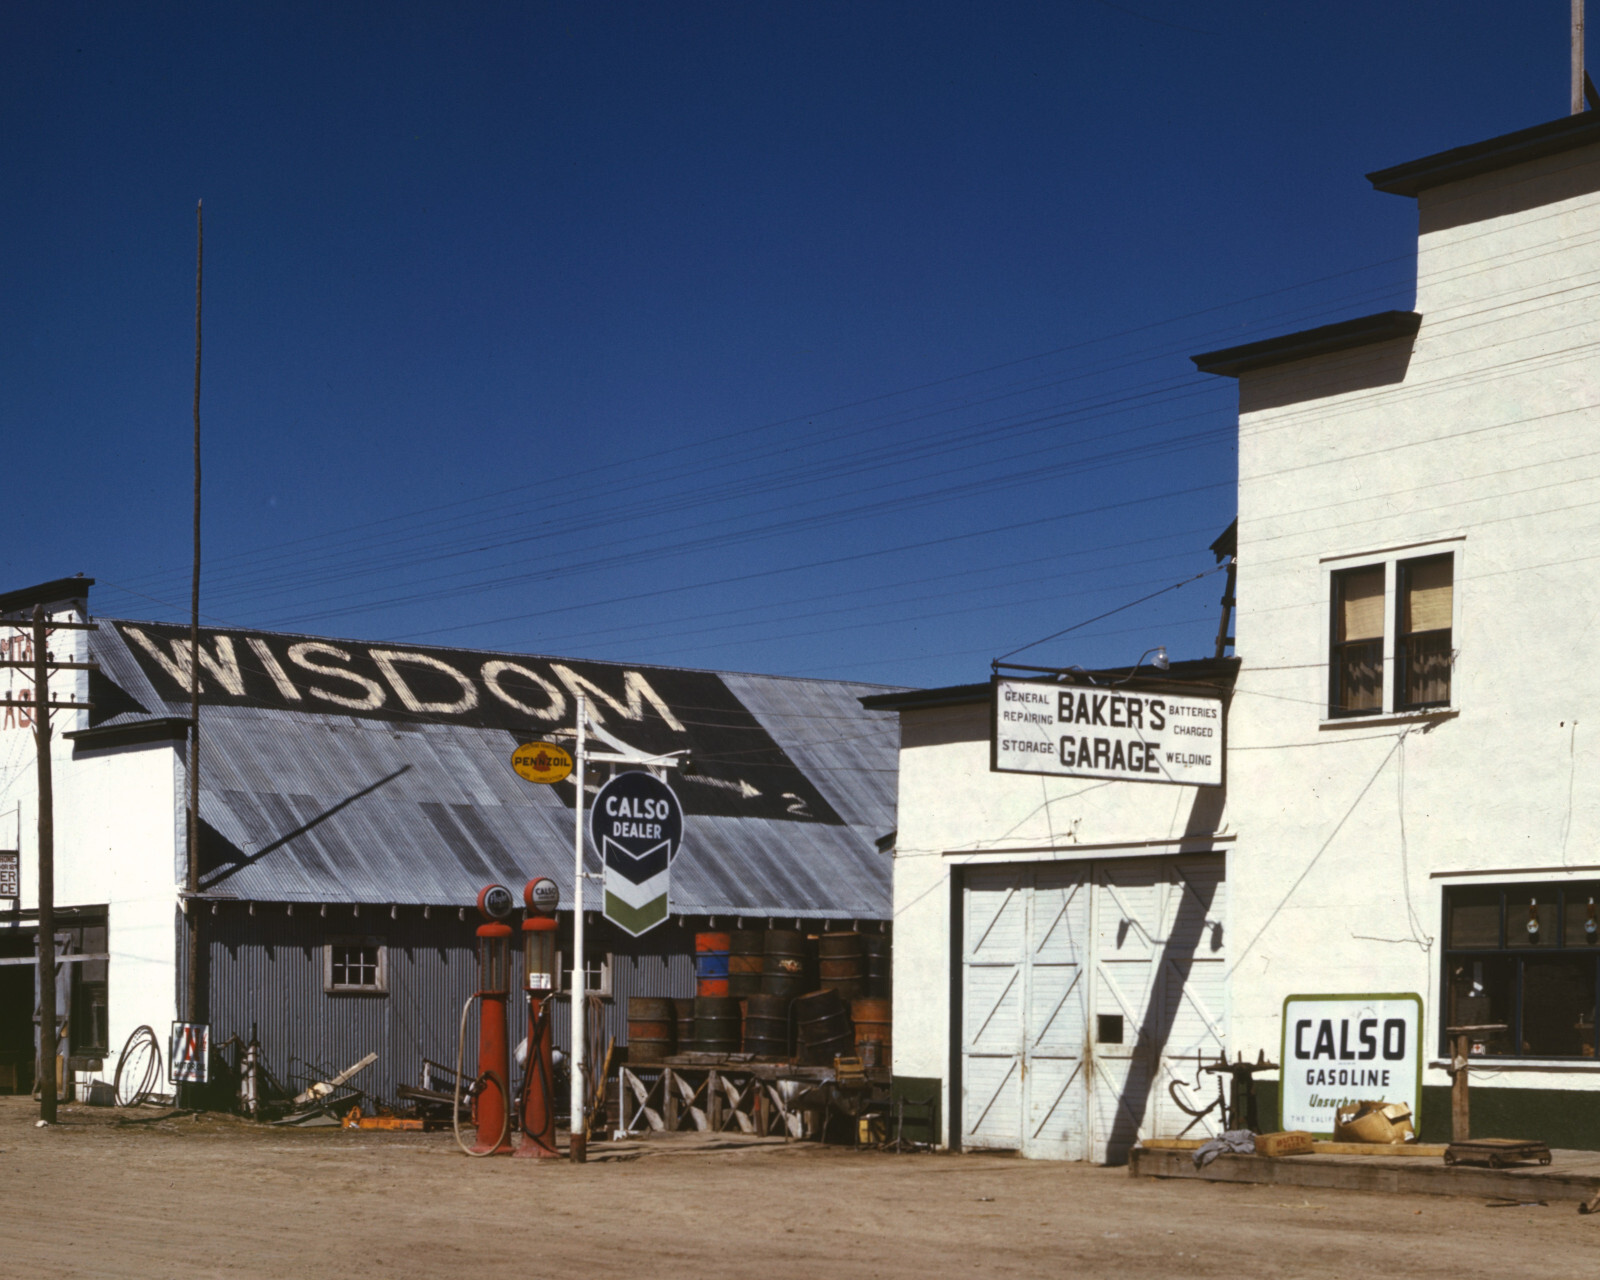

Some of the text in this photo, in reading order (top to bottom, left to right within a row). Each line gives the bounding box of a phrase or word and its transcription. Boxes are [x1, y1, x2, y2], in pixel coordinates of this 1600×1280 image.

[122, 625, 687, 732] WISDOM
[1005, 691, 1050, 705] GENERAL
[1004, 711, 1053, 725] REPAIRING
[1058, 691, 1167, 731] BAKER'S
[1169, 705, 1217, 719] BATTERIES
[1174, 725, 1213, 738] CHARGED
[1002, 739, 1054, 754] STORAGE
[1060, 735, 1161, 773] GARAGE
[1166, 752, 1212, 766] WELDING
[514, 756, 570, 768] PENNZOIL
[605, 796, 669, 820] CALSO
[613, 822, 662, 839] DEALER
[535, 887, 557, 896] CALSO
[1295, 1019, 1406, 1061] CALSO
[1306, 1069, 1390, 1087] GASOLINE
[1311, 1116, 1335, 1124] CALIF
